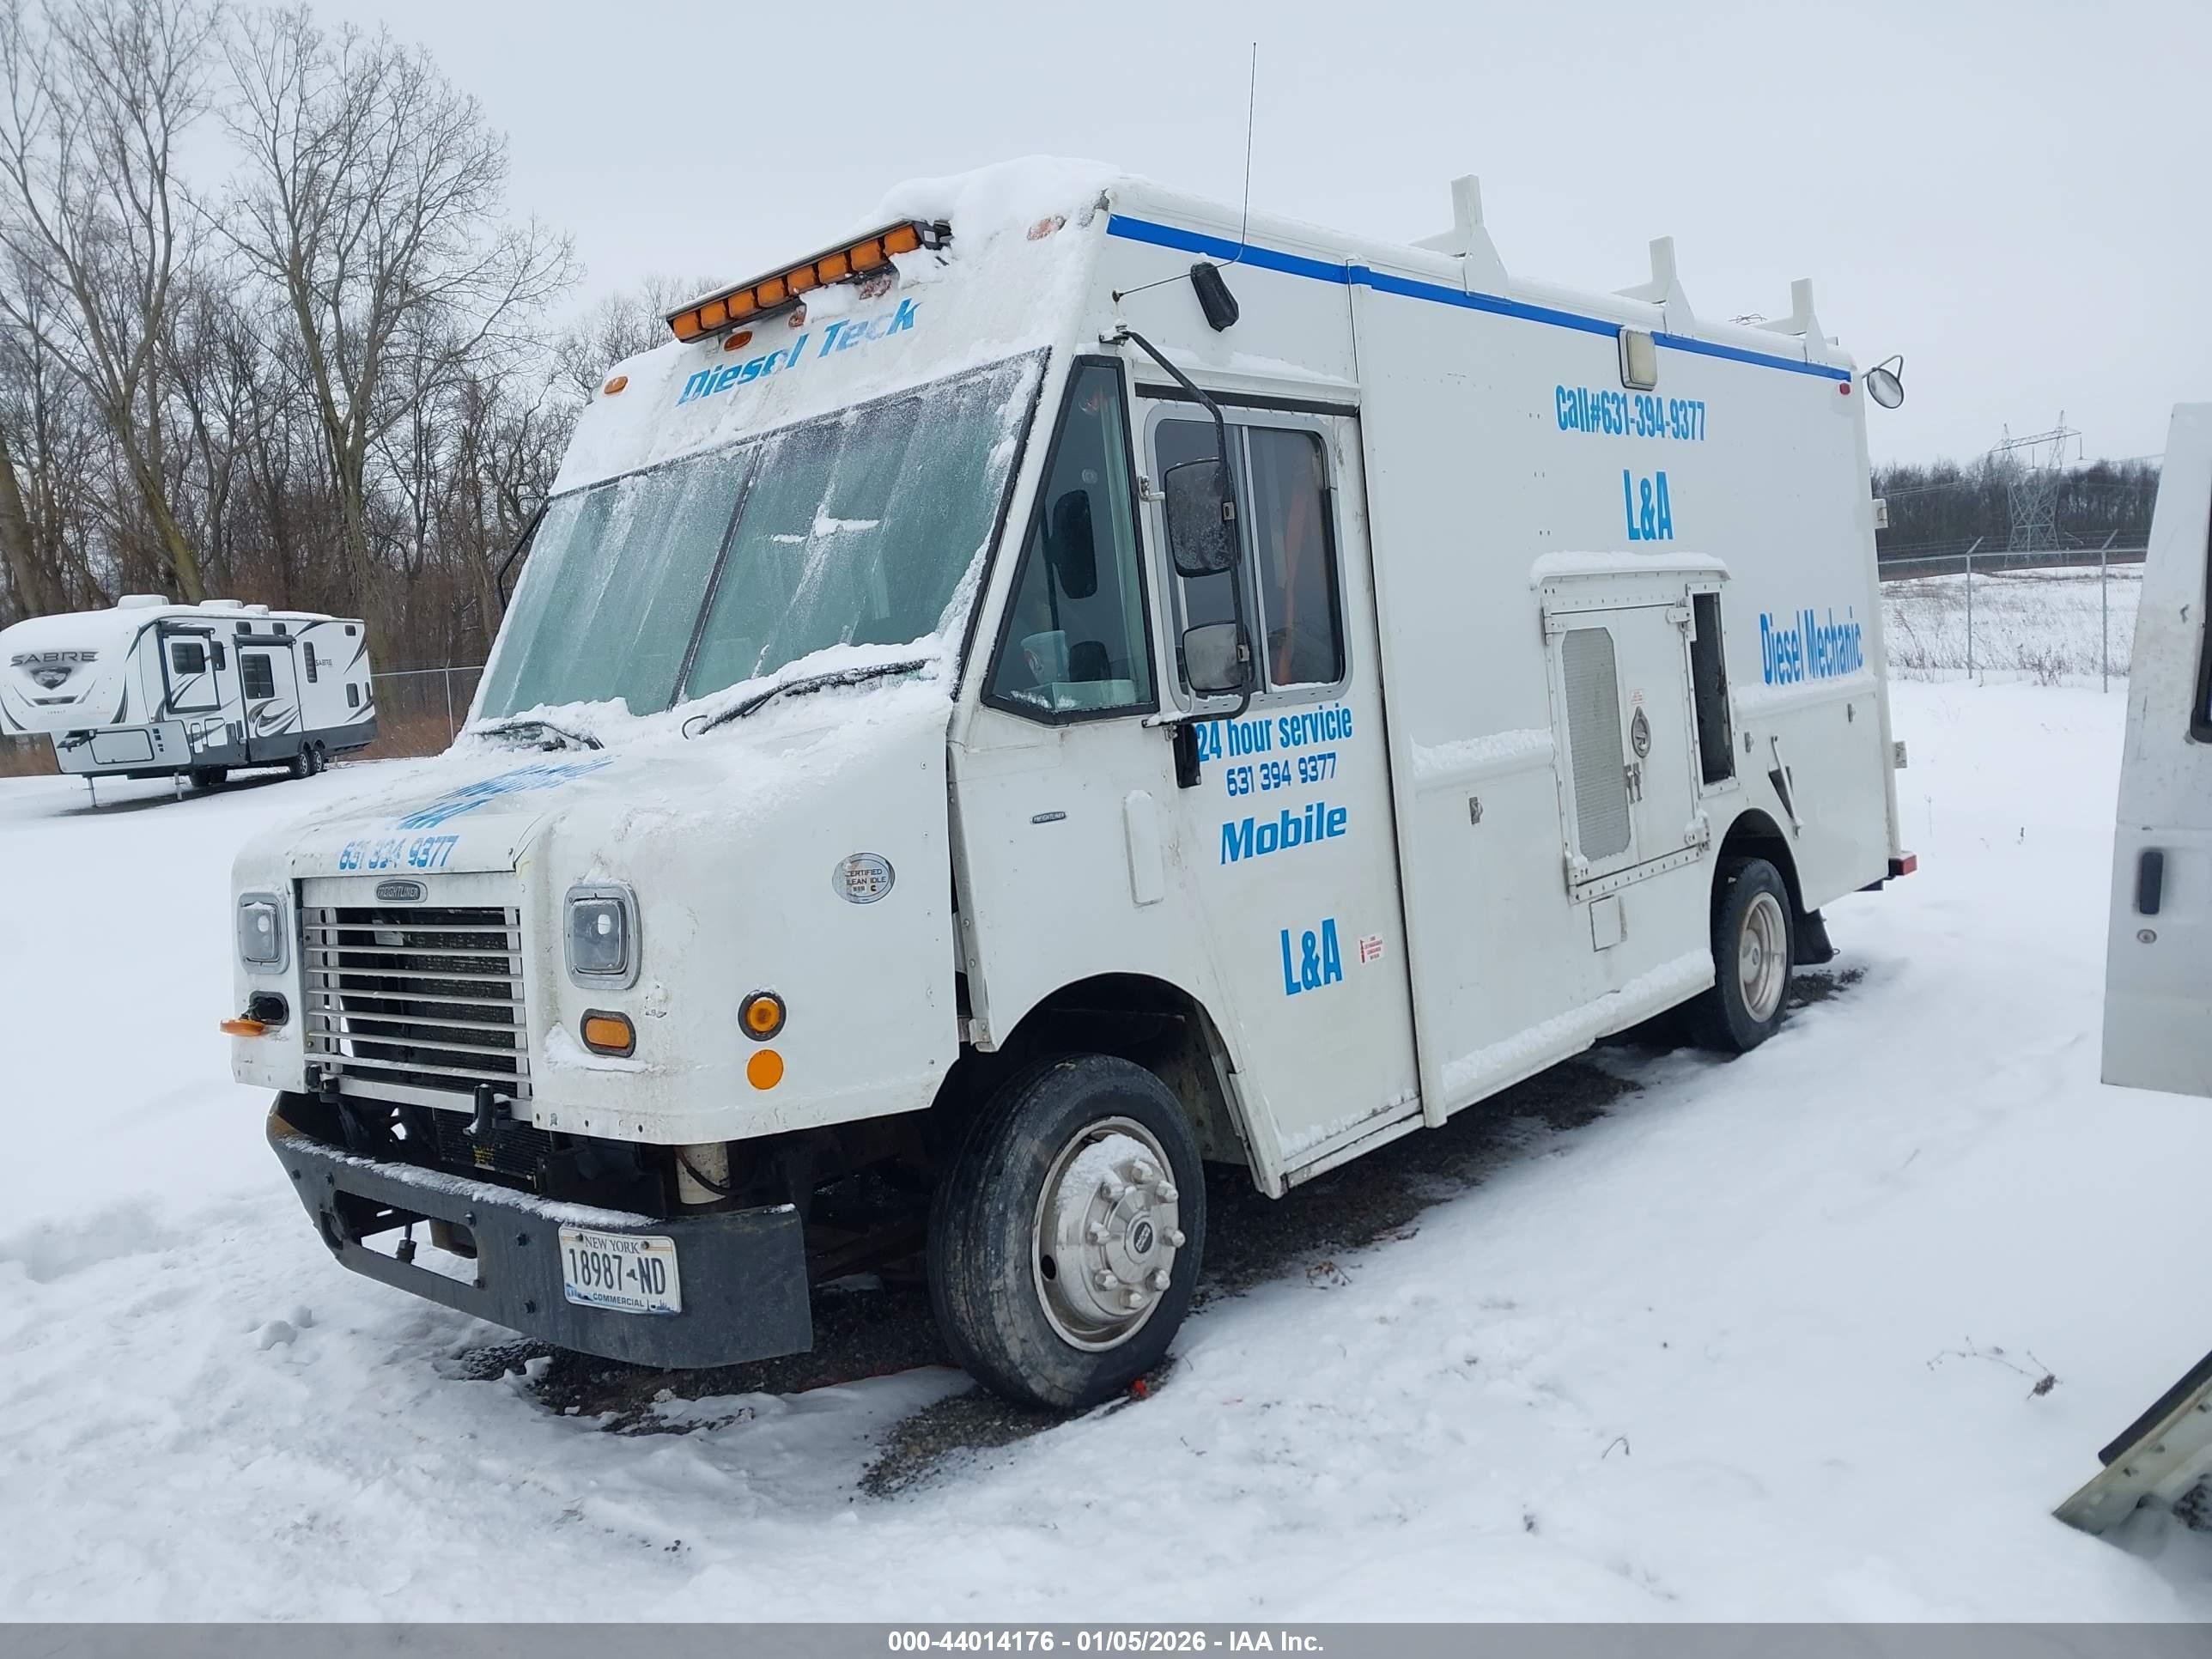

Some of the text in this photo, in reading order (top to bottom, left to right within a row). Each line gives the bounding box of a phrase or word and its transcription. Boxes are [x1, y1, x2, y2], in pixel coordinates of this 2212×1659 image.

[1555, 385, 1705, 441] Call#631-394-9377
[1623, 469, 1674, 541] L&A
[9, 651, 100, 667] SABRE
[1759, 605, 1863, 685] Diesel Mechanic
[1195, 702, 1352, 763] 24 hour servicie
[1226, 751, 1336, 797] 631 394 9377
[408, 835, 459, 868] 9377
[1220, 801, 1347, 866] Mobile
[1280, 918, 1343, 996] L&A
[585, 1236, 640, 1255] NEW YORK
[592, 1292, 645, 1308] COMMERCIAL
